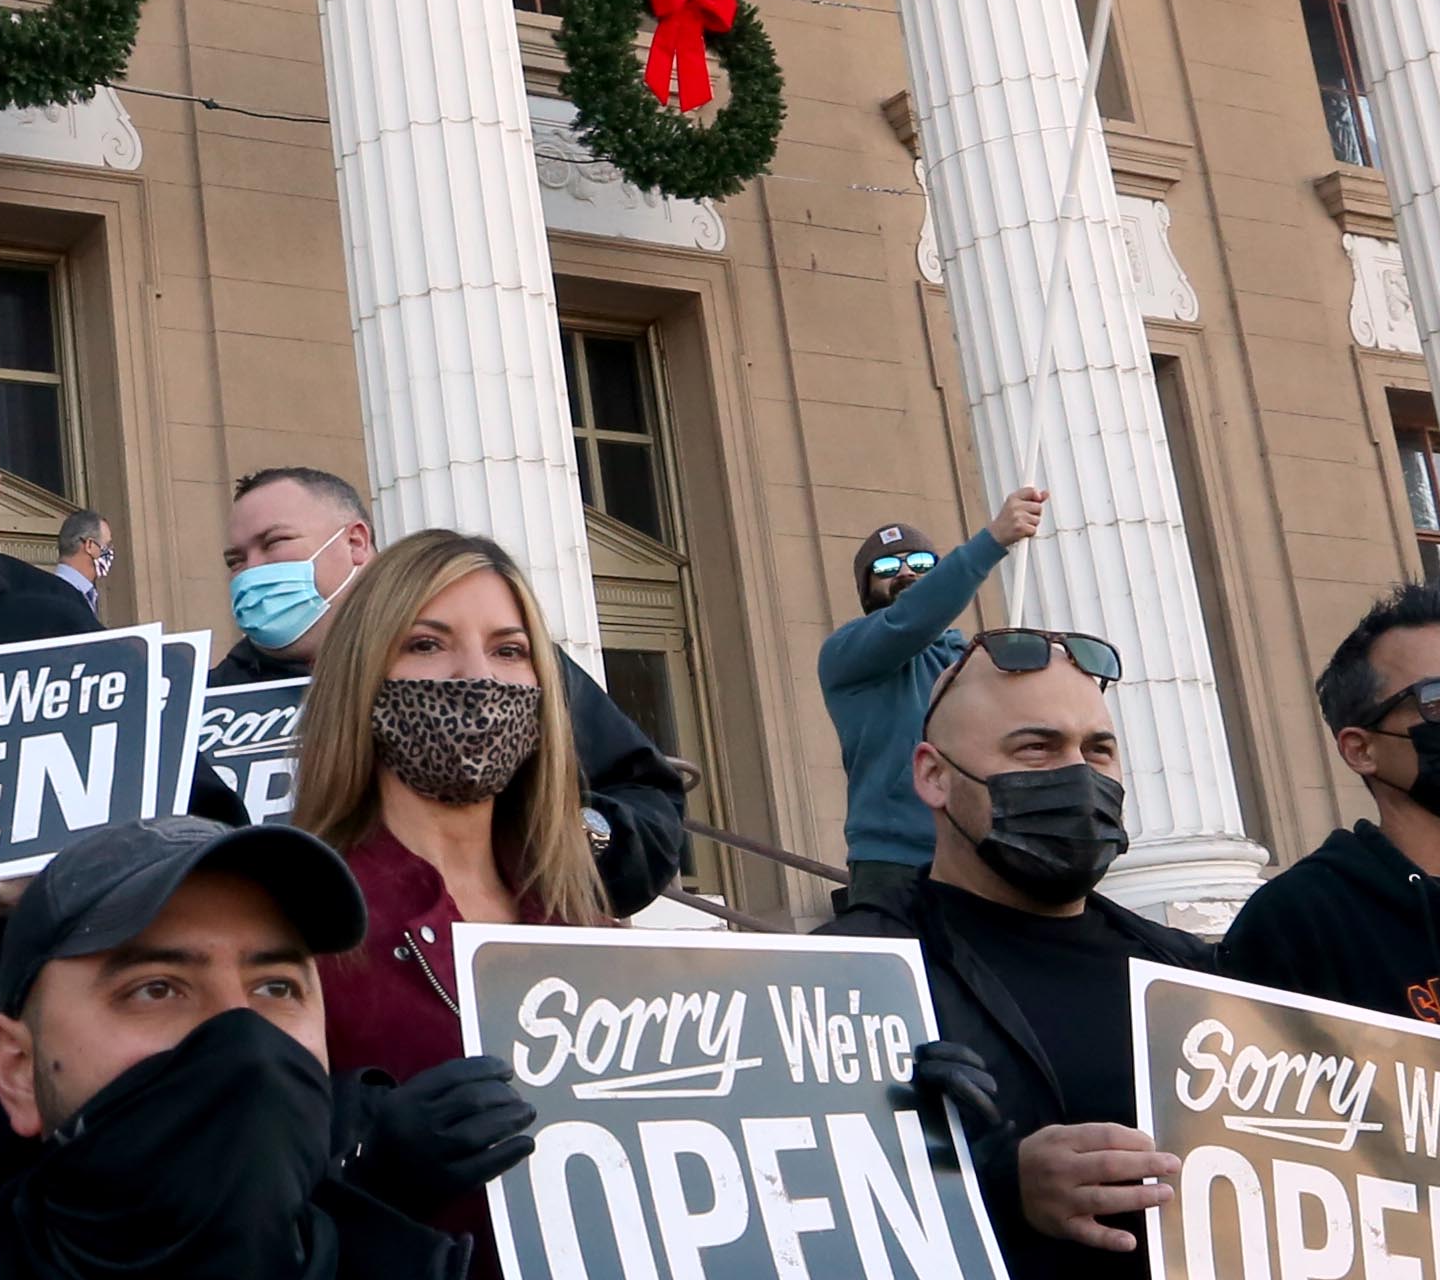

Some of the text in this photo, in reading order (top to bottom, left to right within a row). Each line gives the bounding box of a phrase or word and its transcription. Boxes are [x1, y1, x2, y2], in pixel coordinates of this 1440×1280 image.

[513, 976, 913, 1099] Sorry We're
[1175, 1018, 1383, 1152] Sorry
